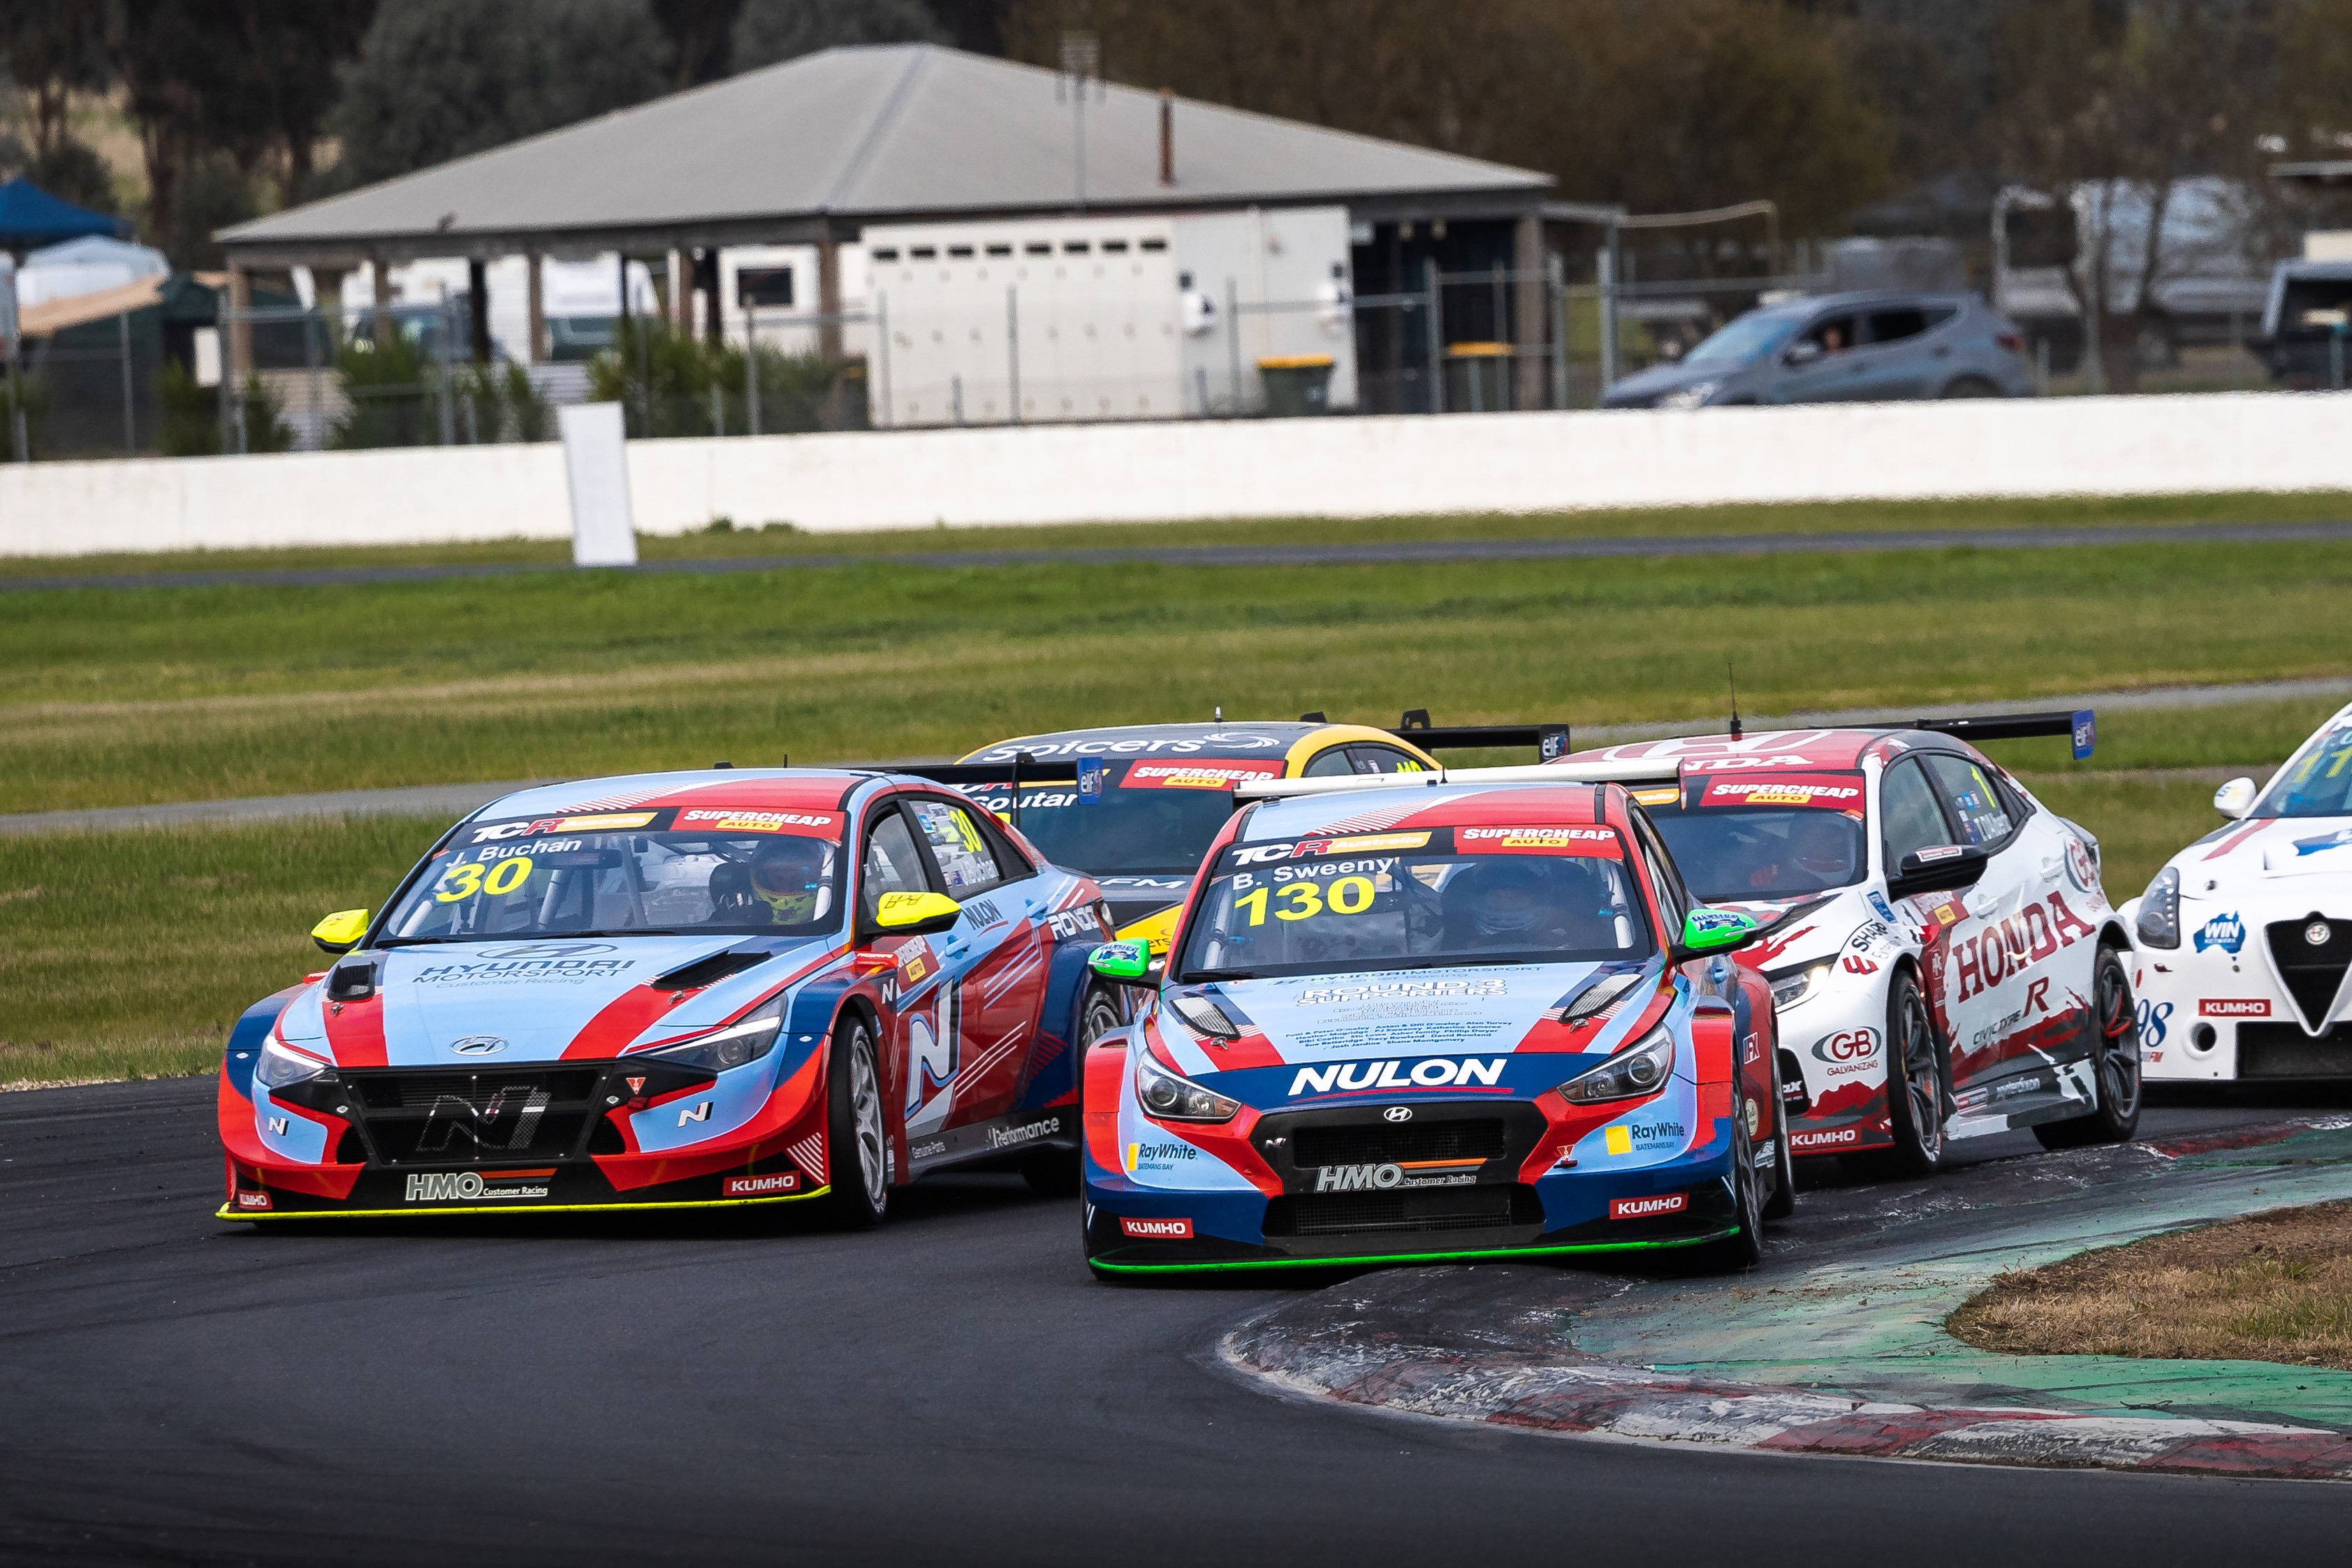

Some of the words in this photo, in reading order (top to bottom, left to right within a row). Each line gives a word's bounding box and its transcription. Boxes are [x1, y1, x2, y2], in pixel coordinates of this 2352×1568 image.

[1134, 766, 1274, 781] SUPERCHEAP
[1172, 777, 1218, 786] AUTO
[1712, 784, 1859, 798] SUPERCHEAP
[683, 809, 832, 827] SUPERCHEAP
[471, 818, 566, 844] TCR
[950, 809, 982, 852] 30
[1463, 828, 1616, 841] SUPERCHEAP
[446, 851, 467, 867] J.
[477, 840, 583, 862] Buchan
[1232, 839, 1334, 866] TCR
[1333, 835, 1424, 850] Australia
[436, 856, 533, 902] 30
[1233, 872, 1263, 891] B.
[1273, 858, 1395, 882] Sweeny
[1234, 876, 1375, 927] 130
[963, 899, 1003, 930] NULON
[2205, 921, 2240, 938] WIN
[1952, 891, 2096, 1004] HONDA
[411, 969, 631, 983] MOTORSPORT
[421, 960, 637, 976] HYUNDAI
[1410, 967, 1544, 975] MOTORSPORT
[436, 979, 518, 988] Customer
[525, 977, 585, 986] Racing
[1303, 980, 1470, 999] ROUND
[1476, 979, 1507, 990] 3
[1296, 988, 1509, 1006] SUPPORTERS
[2205, 1002, 2265, 1014] KUMHO
[1832, 1030, 1872, 1060] GB
[1827, 1060, 1878, 1076] GALVANIZING
[1287, 1059, 1507, 1096] NULON
[1632, 1122, 1685, 1141] RayWhite
[1791, 1129, 1855, 1146] KUMHO
[1139, 1143, 1197, 1160] RayWhite
[406, 1172, 483, 1201] HMO
[483, 1187, 520, 1196] Customer
[521, 1185, 548, 1195] Racing
[731, 1175, 795, 1192] KUMHO
[1314, 1162, 1403, 1193] HMO
[1403, 1177, 1445, 1186] Customer
[1447, 1175, 1476, 1185] Racing
[1618, 1196, 1682, 1215] KUMHO
[1127, 1222, 1186, 1234] KUMHO
